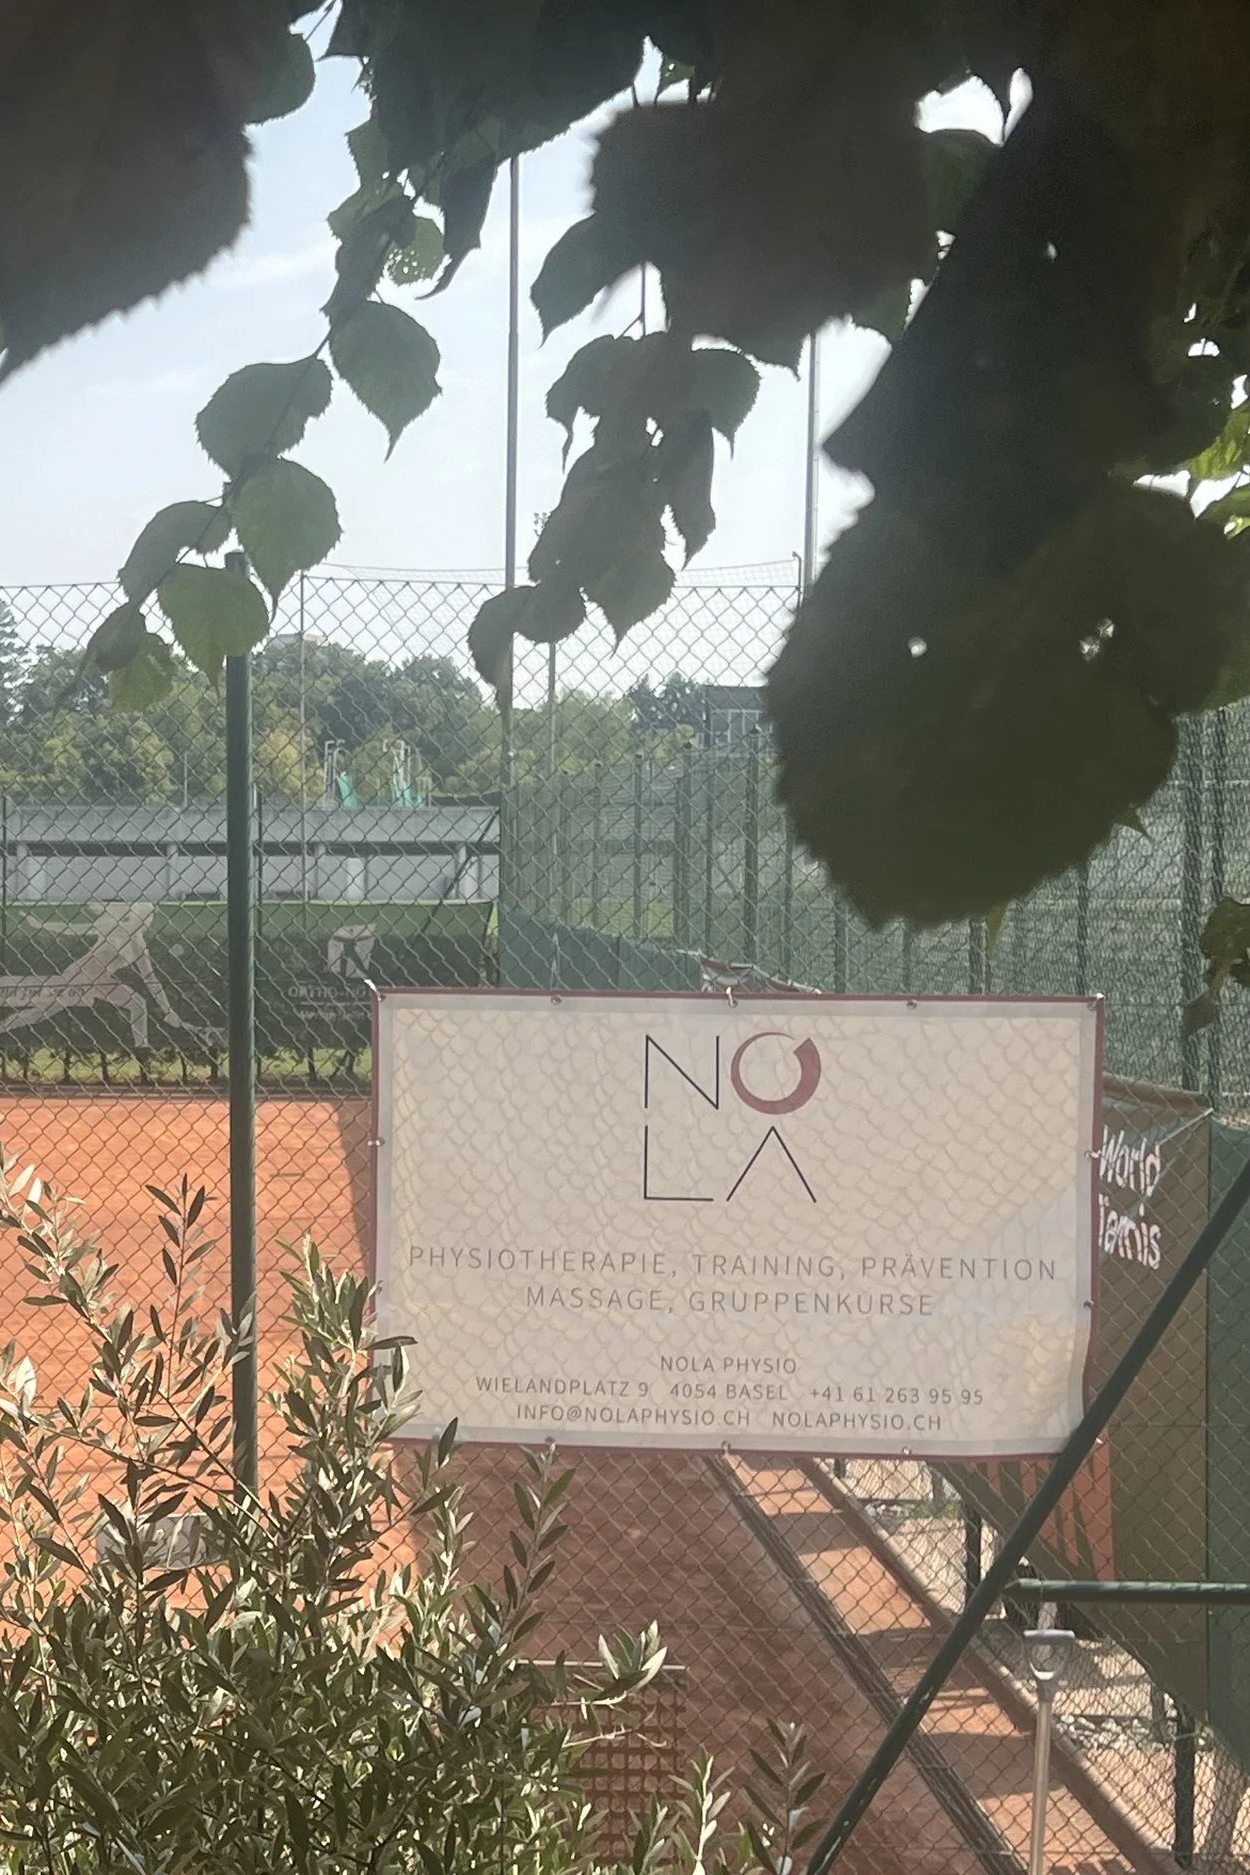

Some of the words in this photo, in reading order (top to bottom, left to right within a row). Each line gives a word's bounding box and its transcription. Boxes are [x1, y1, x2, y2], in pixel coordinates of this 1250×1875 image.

[409, 1246, 676, 1279] PHYSIOTHERAPIE,
[692, 1254, 845, 1280] TRAINING,
[861, 1252, 1055, 1281] PRÄVENTION
[526, 1287, 673, 1315] MASSAGE,
[689, 1291, 933, 1316] GRUPPENKURSE
[660, 1356, 715, 1373] NOLA
[723, 1357, 797, 1374] PHYSIO
[476, 1376, 630, 1398] WIELANDPLATZ
[638, 1381, 649, 1398] 9
[669, 1383, 717, 1400] 4054
[726, 1384, 788, 1401] BASEL
[810, 1386, 844, 1402] +41
[853, 1387, 874, 1403] 61
[885, 1388, 920, 1404] 263
[929, 1388, 952, 1405] 95
[960, 1389, 984, 1406] 95
[516, 1404, 750, 1427] INFO@NOLAPHYSIO.CH
[772, 1411, 942, 1432] NOLAPHYSIO.CH
